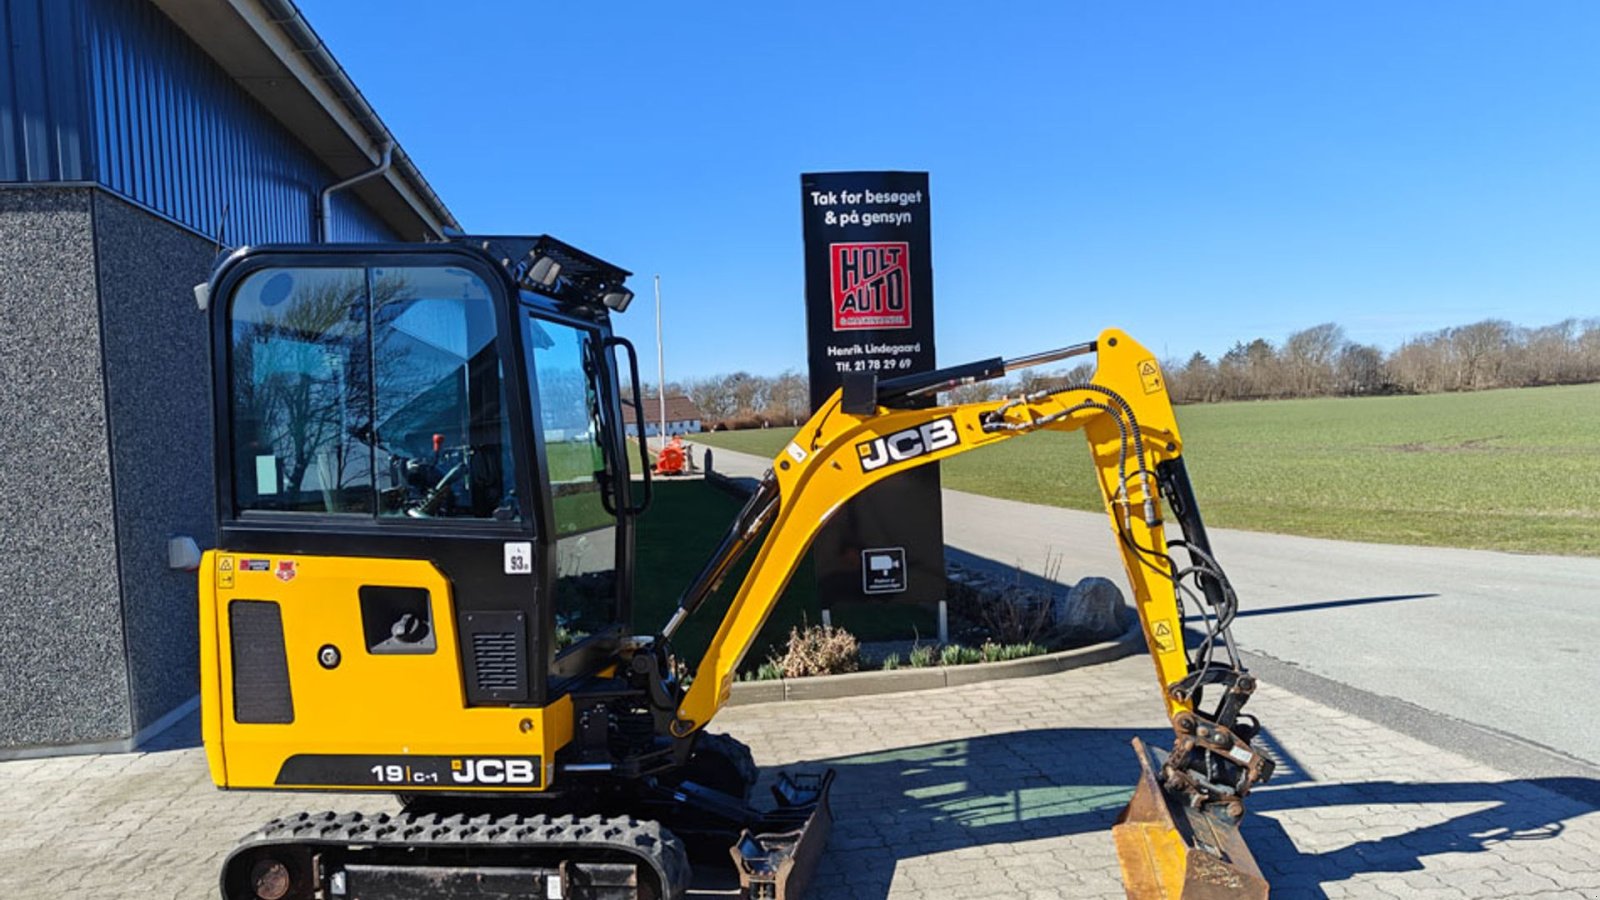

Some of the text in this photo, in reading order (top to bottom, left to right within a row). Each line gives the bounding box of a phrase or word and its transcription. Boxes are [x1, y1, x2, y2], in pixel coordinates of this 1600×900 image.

[811, 189, 922, 206] Tak for besøget
[825, 210, 912, 227] & på gensyn
[840, 247, 902, 293] HOLT
[839, 266, 905, 313] AUTO
[827, 342, 921, 356] Henrik Lindegaard
[854, 360, 866, 371] 21
[868, 360, 881, 370] 78
[883, 359, 897, 370] 29
[858, 419, 958, 470] JCB
[371, 765, 403, 782] 19
[452, 760, 535, 783] JCB
